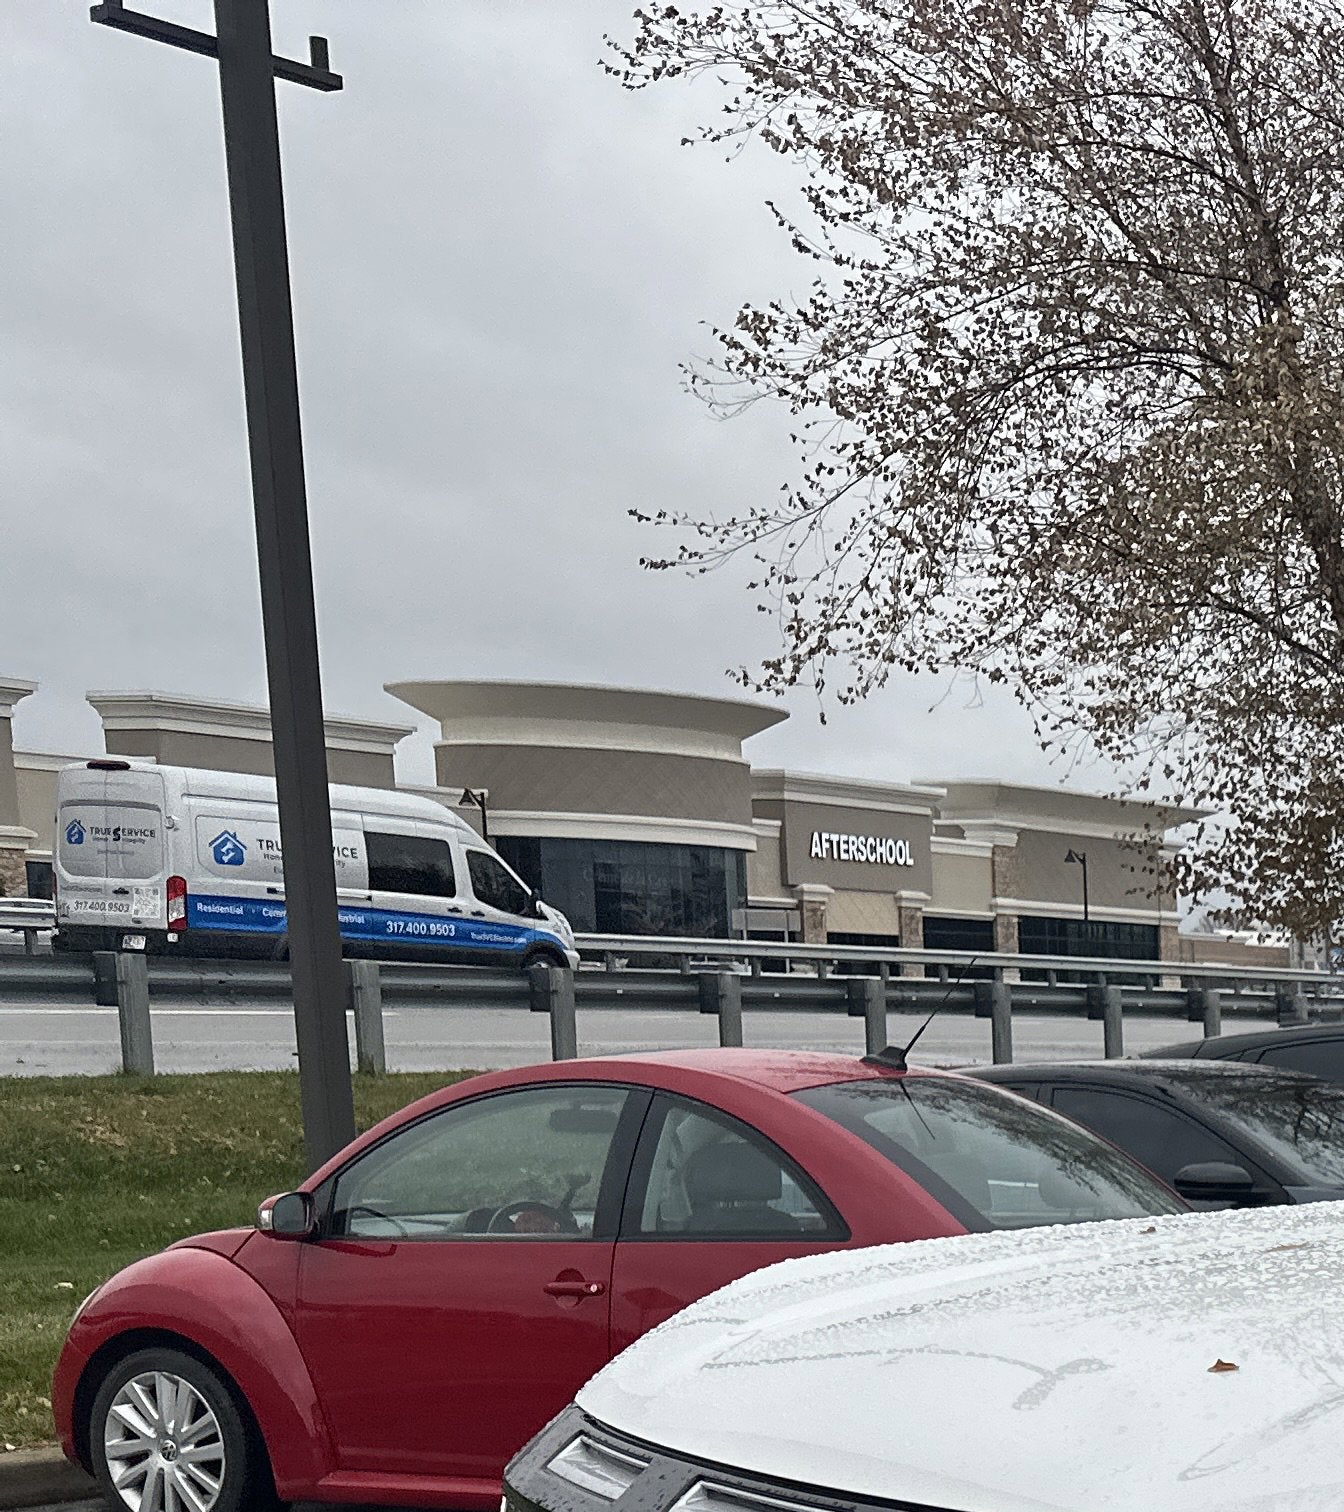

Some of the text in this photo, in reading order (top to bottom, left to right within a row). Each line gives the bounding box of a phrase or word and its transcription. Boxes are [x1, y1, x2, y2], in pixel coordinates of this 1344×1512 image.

[256, 838, 282, 852] TRU
[810, 830, 915, 866] AFTERSCHOOL
[196, 902, 244, 915] Residential
[386, 920, 456, 937] 317.400.9503
